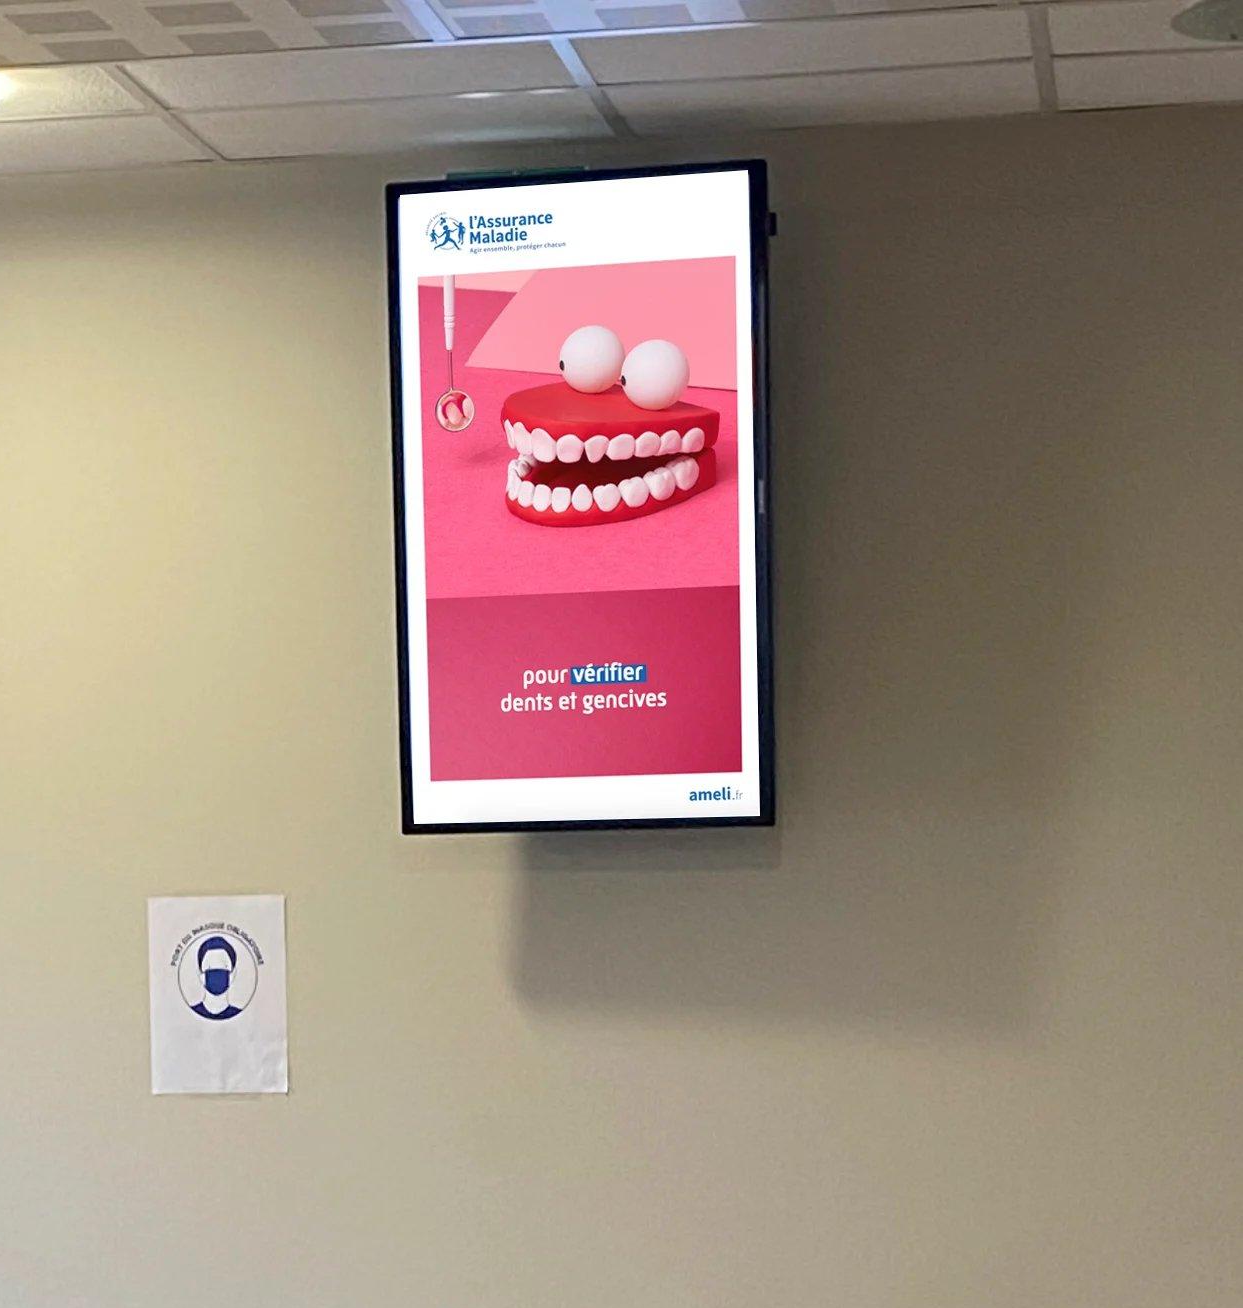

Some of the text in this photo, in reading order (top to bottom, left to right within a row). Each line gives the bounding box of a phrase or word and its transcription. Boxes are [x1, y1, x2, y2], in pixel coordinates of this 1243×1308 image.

[469, 229, 528, 244] Maladie
[483, 244, 516, 253] ensemble,
[516, 242, 543, 252] protéger
[523, 662, 644, 689] pour vérifier
[500, 689, 667, 715] dents et gencives
[689, 787, 743, 801] ameli.fr
